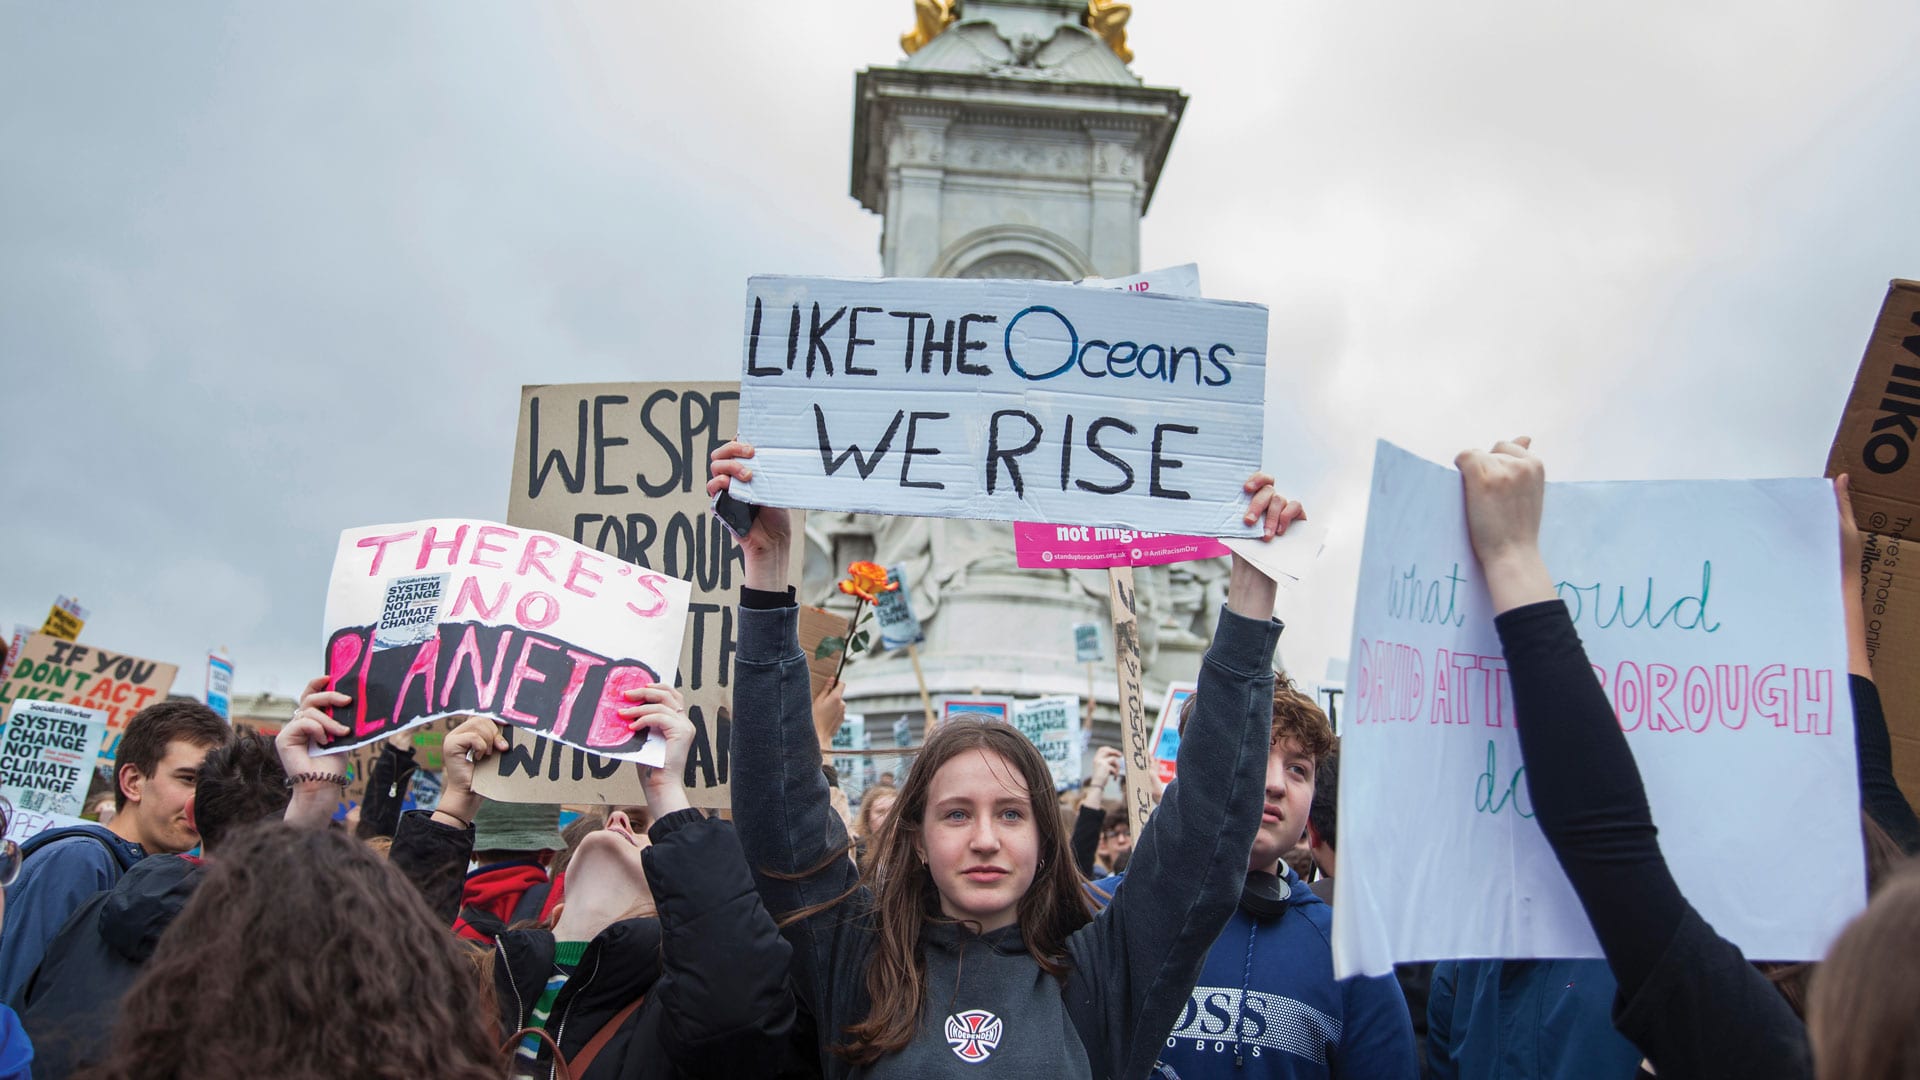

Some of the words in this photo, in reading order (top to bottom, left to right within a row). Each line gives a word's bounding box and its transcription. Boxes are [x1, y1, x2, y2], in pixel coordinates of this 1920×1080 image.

[747, 296, 884, 380] LIKE
[888, 310, 998, 377] THE
[1004, 304, 1235, 387] Oceans
[528, 394, 630, 500] WE
[813, 402, 951, 490] WE
[985, 409, 1199, 500] RISE
[1056, 526, 1090, 542] not
[1143, 545, 1198, 557] @AntiRacismDay
[356, 524, 667, 618] THERE'S
[386, 589, 441, 603] CHANGE
[388, 581, 440, 595] SYSTEM
[1553, 559, 1721, 633] ould
[1872, 571, 1894, 616] more
[382, 605, 438, 621] CLIMATE
[384, 601, 411, 612] NOT
[450, 575, 560, 630] NO
[380, 614, 434, 630] CHANGE
[45, 640, 89, 667] IF
[93, 651, 157, 685] YOU
[87, 657, 157, 709] ACT
[328, 625, 607, 744] PLANET
[1356, 638, 1425, 725] DAVID
[12, 713, 87, 738] SYSTEM
[3, 741, 43, 760] NOT
[8, 727, 88, 752] CHANGE
[0, 756, 81, 782] CLIMATE
[949, 1022, 999, 1043] INDEPENDENT
